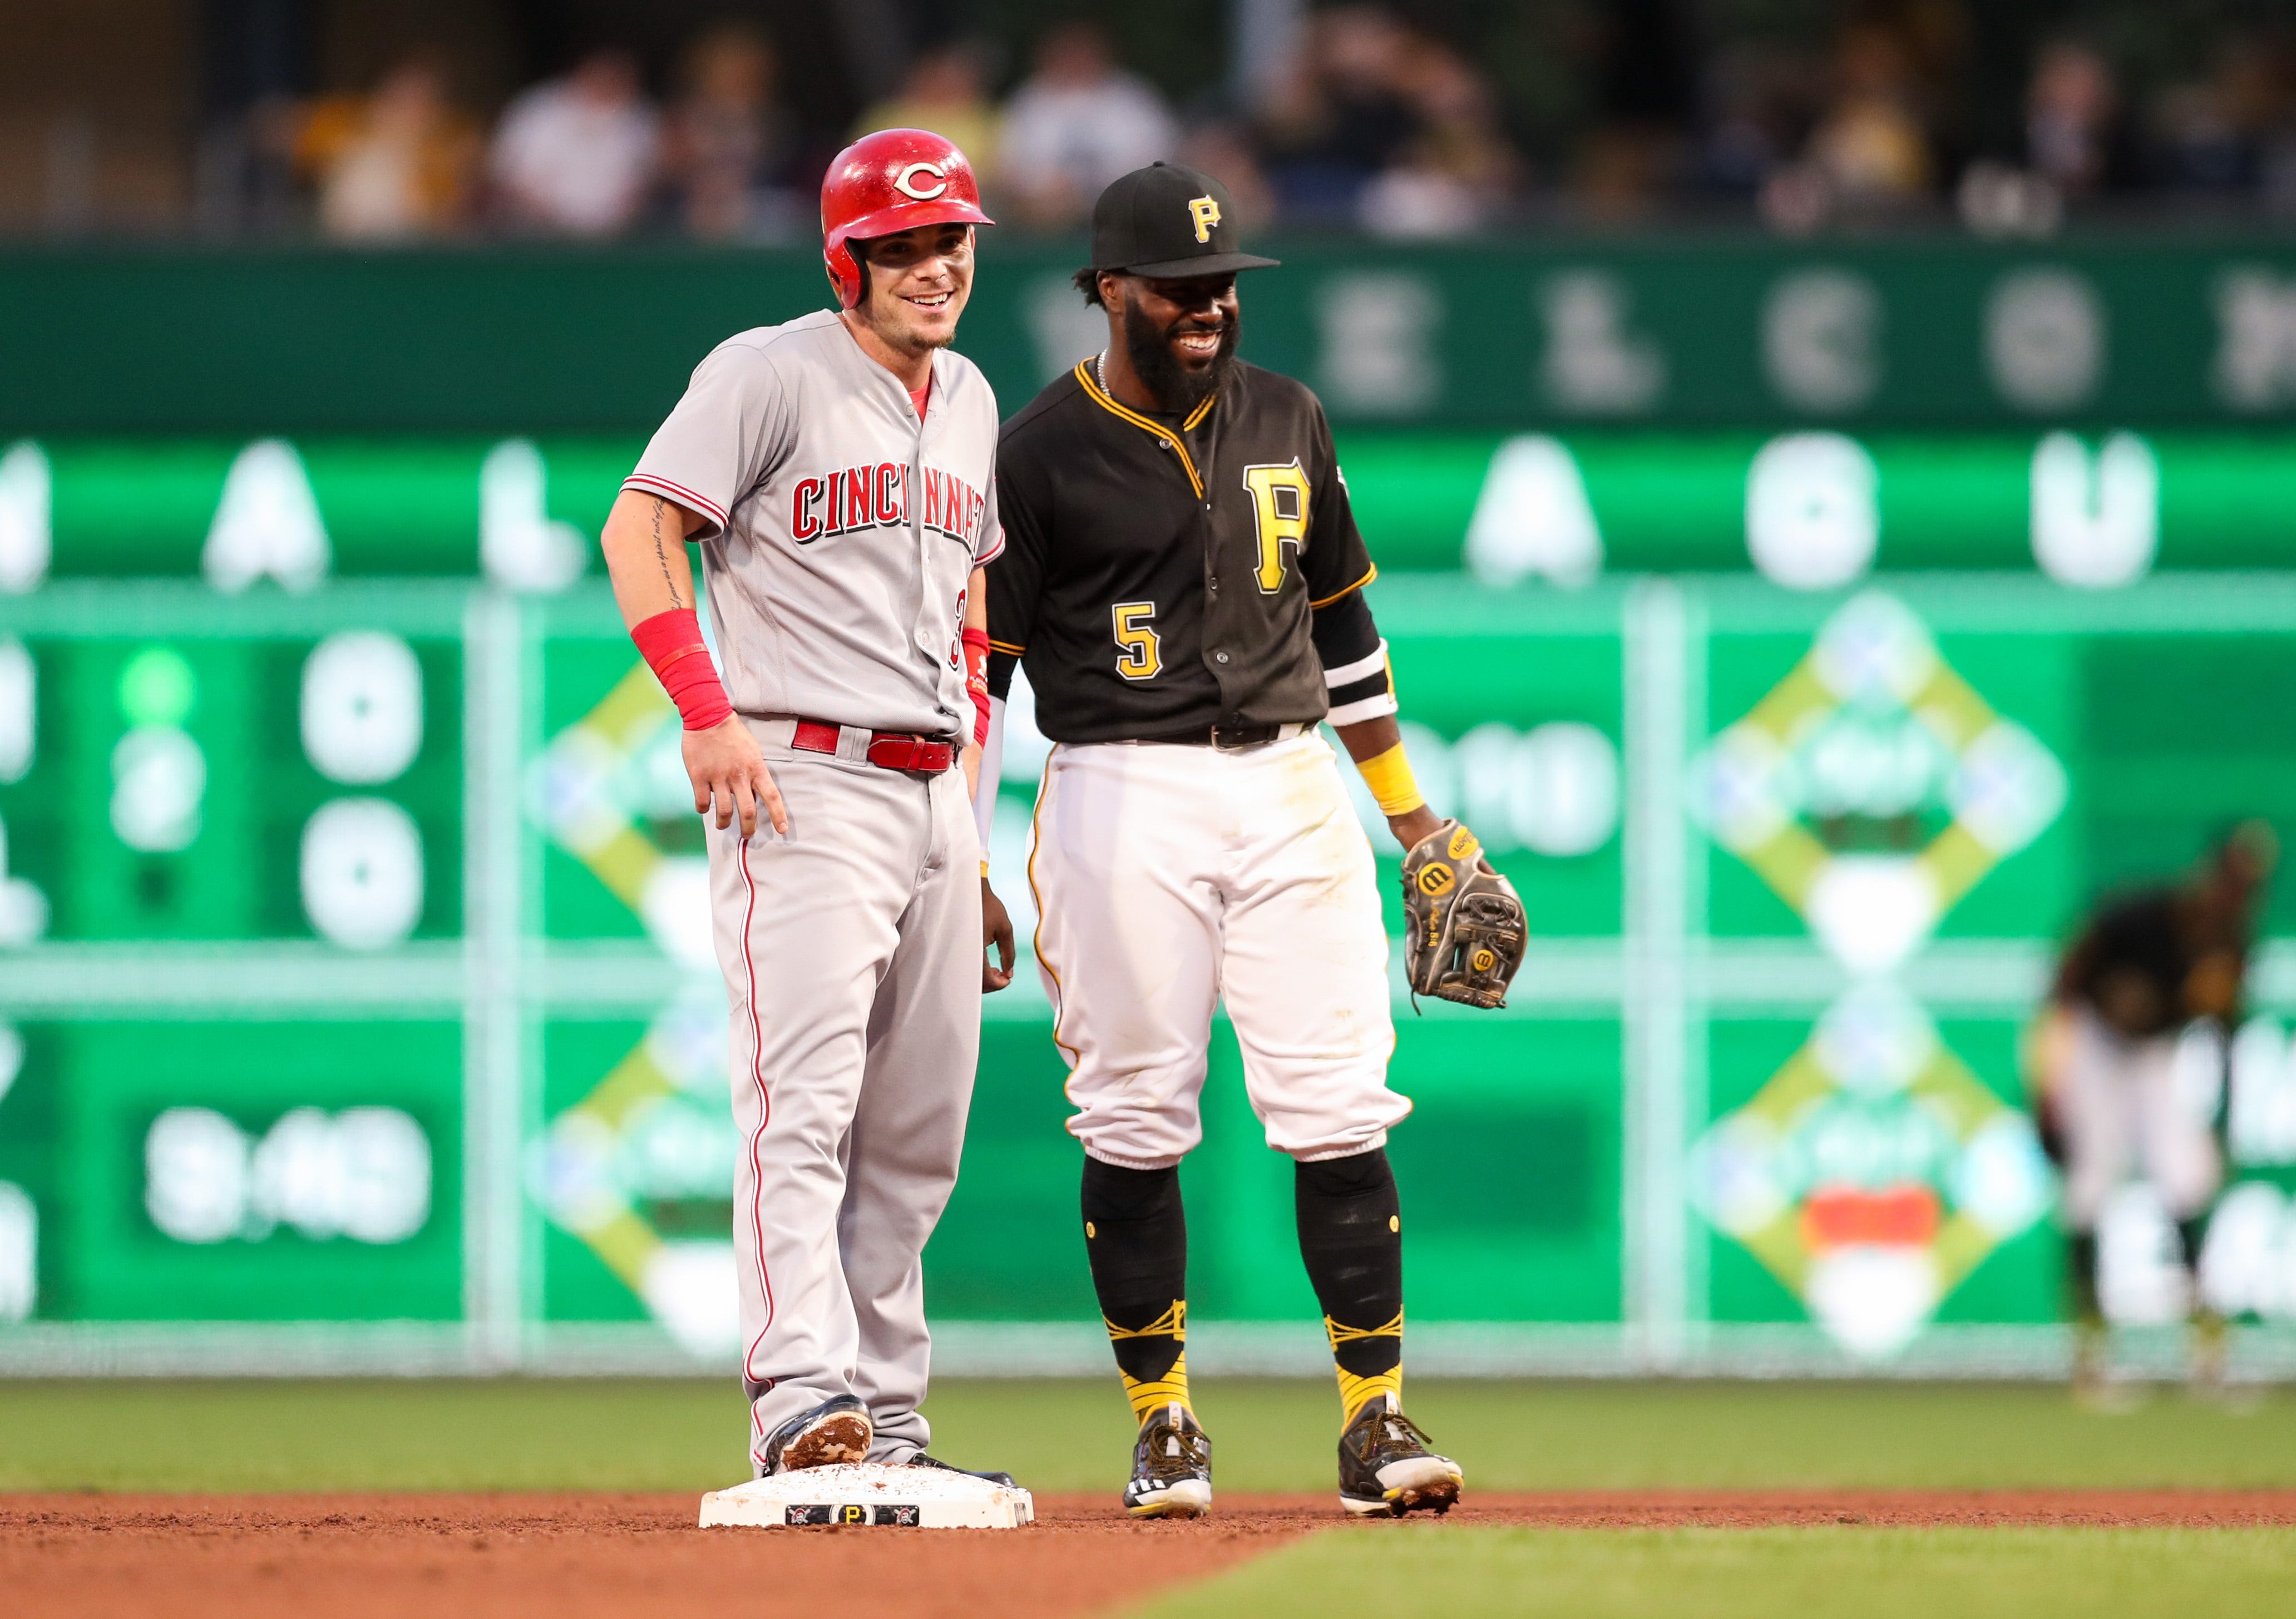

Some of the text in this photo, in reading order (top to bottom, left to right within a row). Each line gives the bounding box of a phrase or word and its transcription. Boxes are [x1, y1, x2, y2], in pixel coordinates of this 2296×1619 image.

[893, 162, 947, 201] C
[1188, 195, 1221, 243] P
[1242, 456, 1312, 595] P
[1112, 601, 1163, 680] 5
[845, 1506, 861, 1525] P
